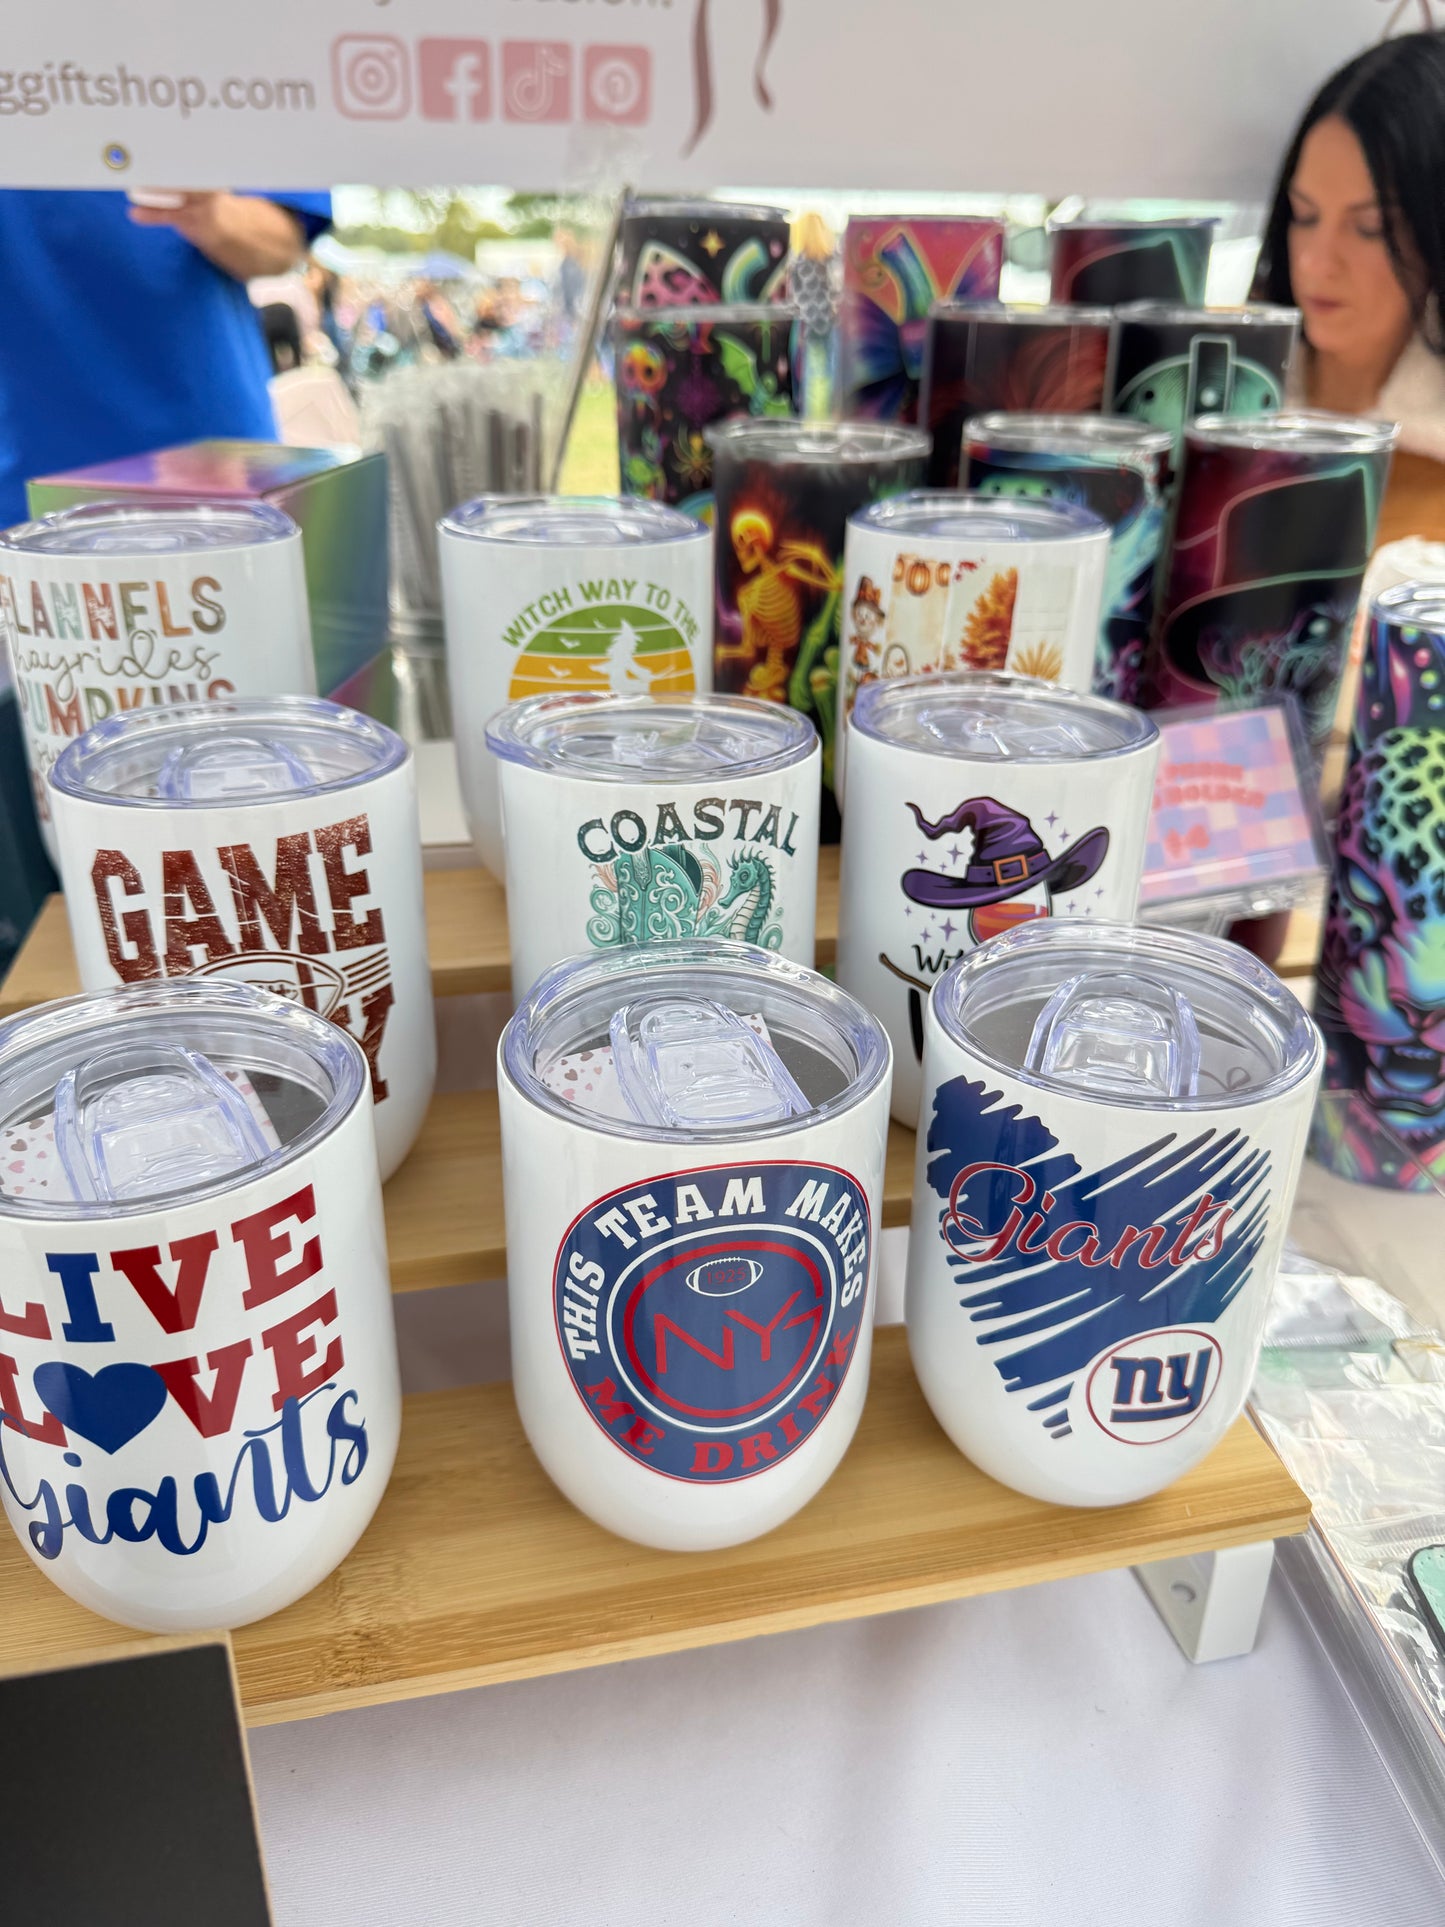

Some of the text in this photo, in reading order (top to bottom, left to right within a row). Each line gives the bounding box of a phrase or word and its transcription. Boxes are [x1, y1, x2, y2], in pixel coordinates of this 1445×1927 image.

[502, 578, 699, 647] WITCH WAY TO THE
[577, 797, 799, 864] COASTAL
[91, 813, 387, 985] GAME
[563, 1176, 867, 1360] THIS TEAM MAKES
[942, 1161, 1236, 1269] Giants
[706, 1267, 747, 1286] 1925
[584, 1324, 856, 1473] ME DRINK
